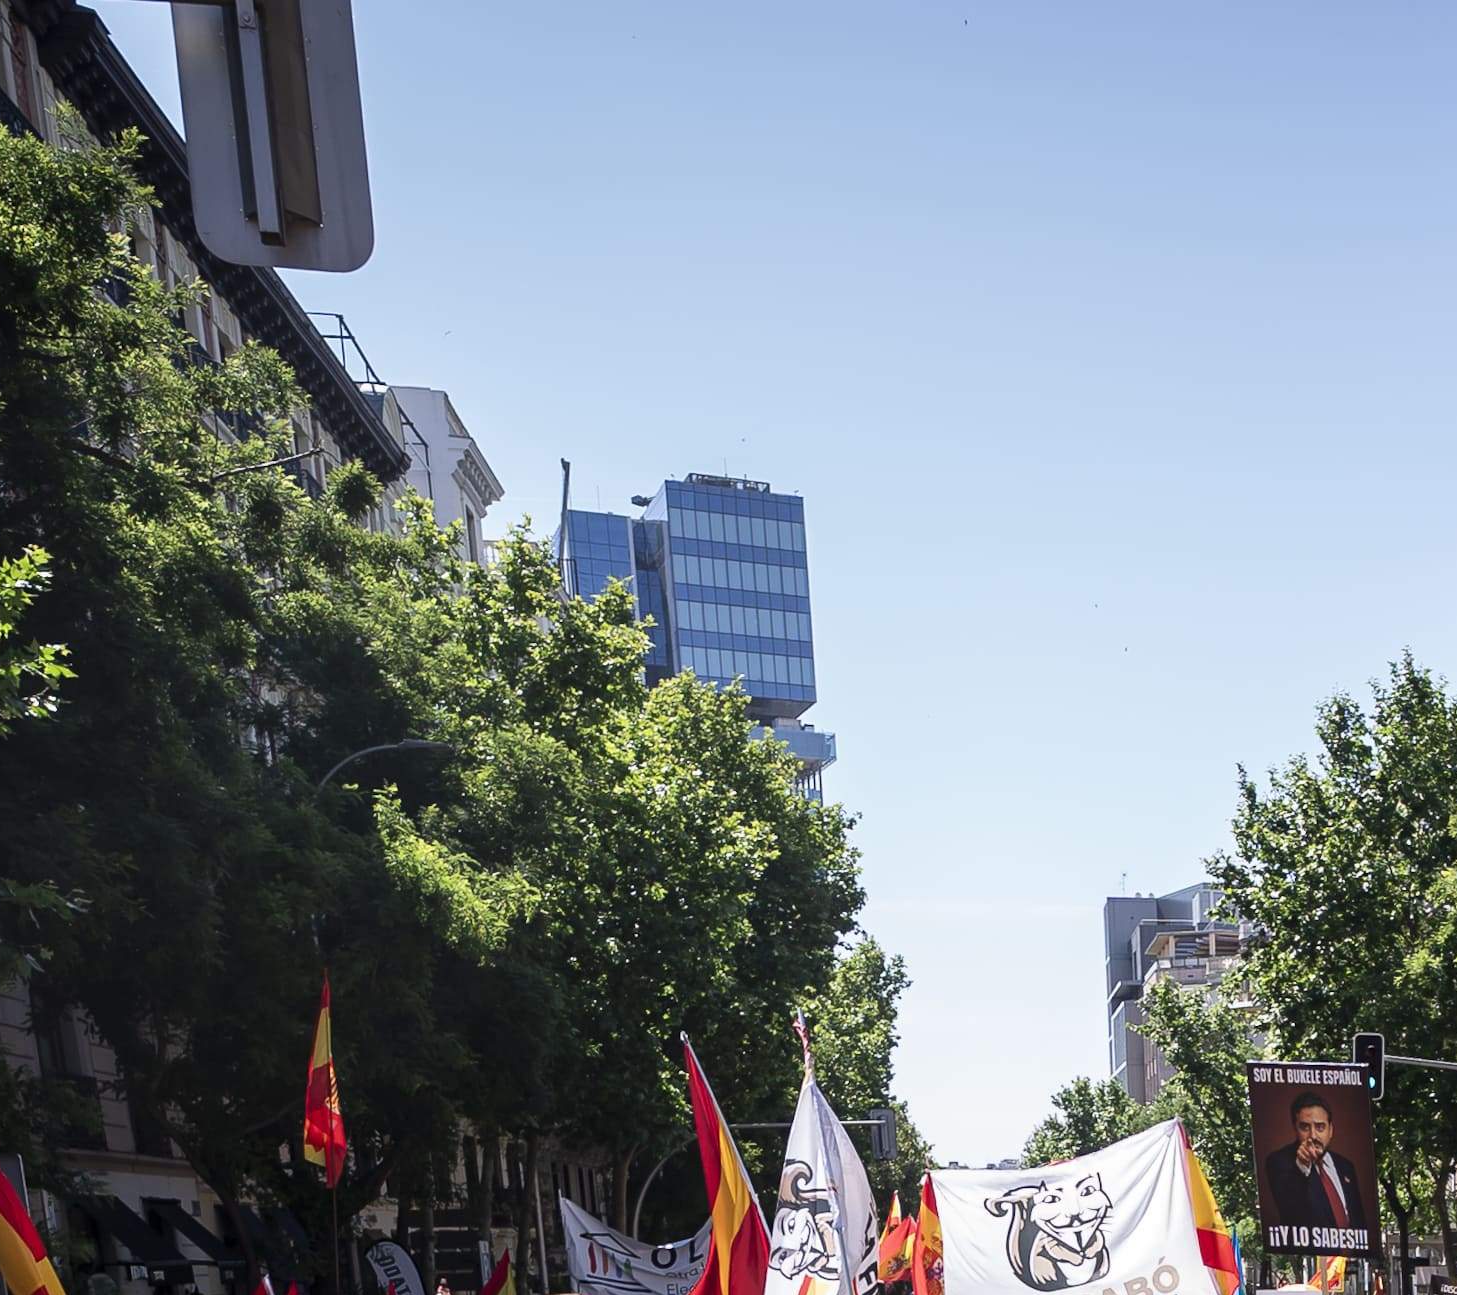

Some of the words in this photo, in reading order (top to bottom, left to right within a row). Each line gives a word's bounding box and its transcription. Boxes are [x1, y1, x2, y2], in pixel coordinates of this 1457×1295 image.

[1253, 1067, 1272, 1083] SOY
[1274, 1068, 1285, 1083] EL
[1287, 1068, 1321, 1085] BUKELE
[1322, 1068, 1362, 1086] ESPAÑOL
[1269, 1225, 1289, 1248] ¡¡Y
[1292, 1226, 1309, 1247] LO
[1312, 1226, 1369, 1250] SABES!!!
